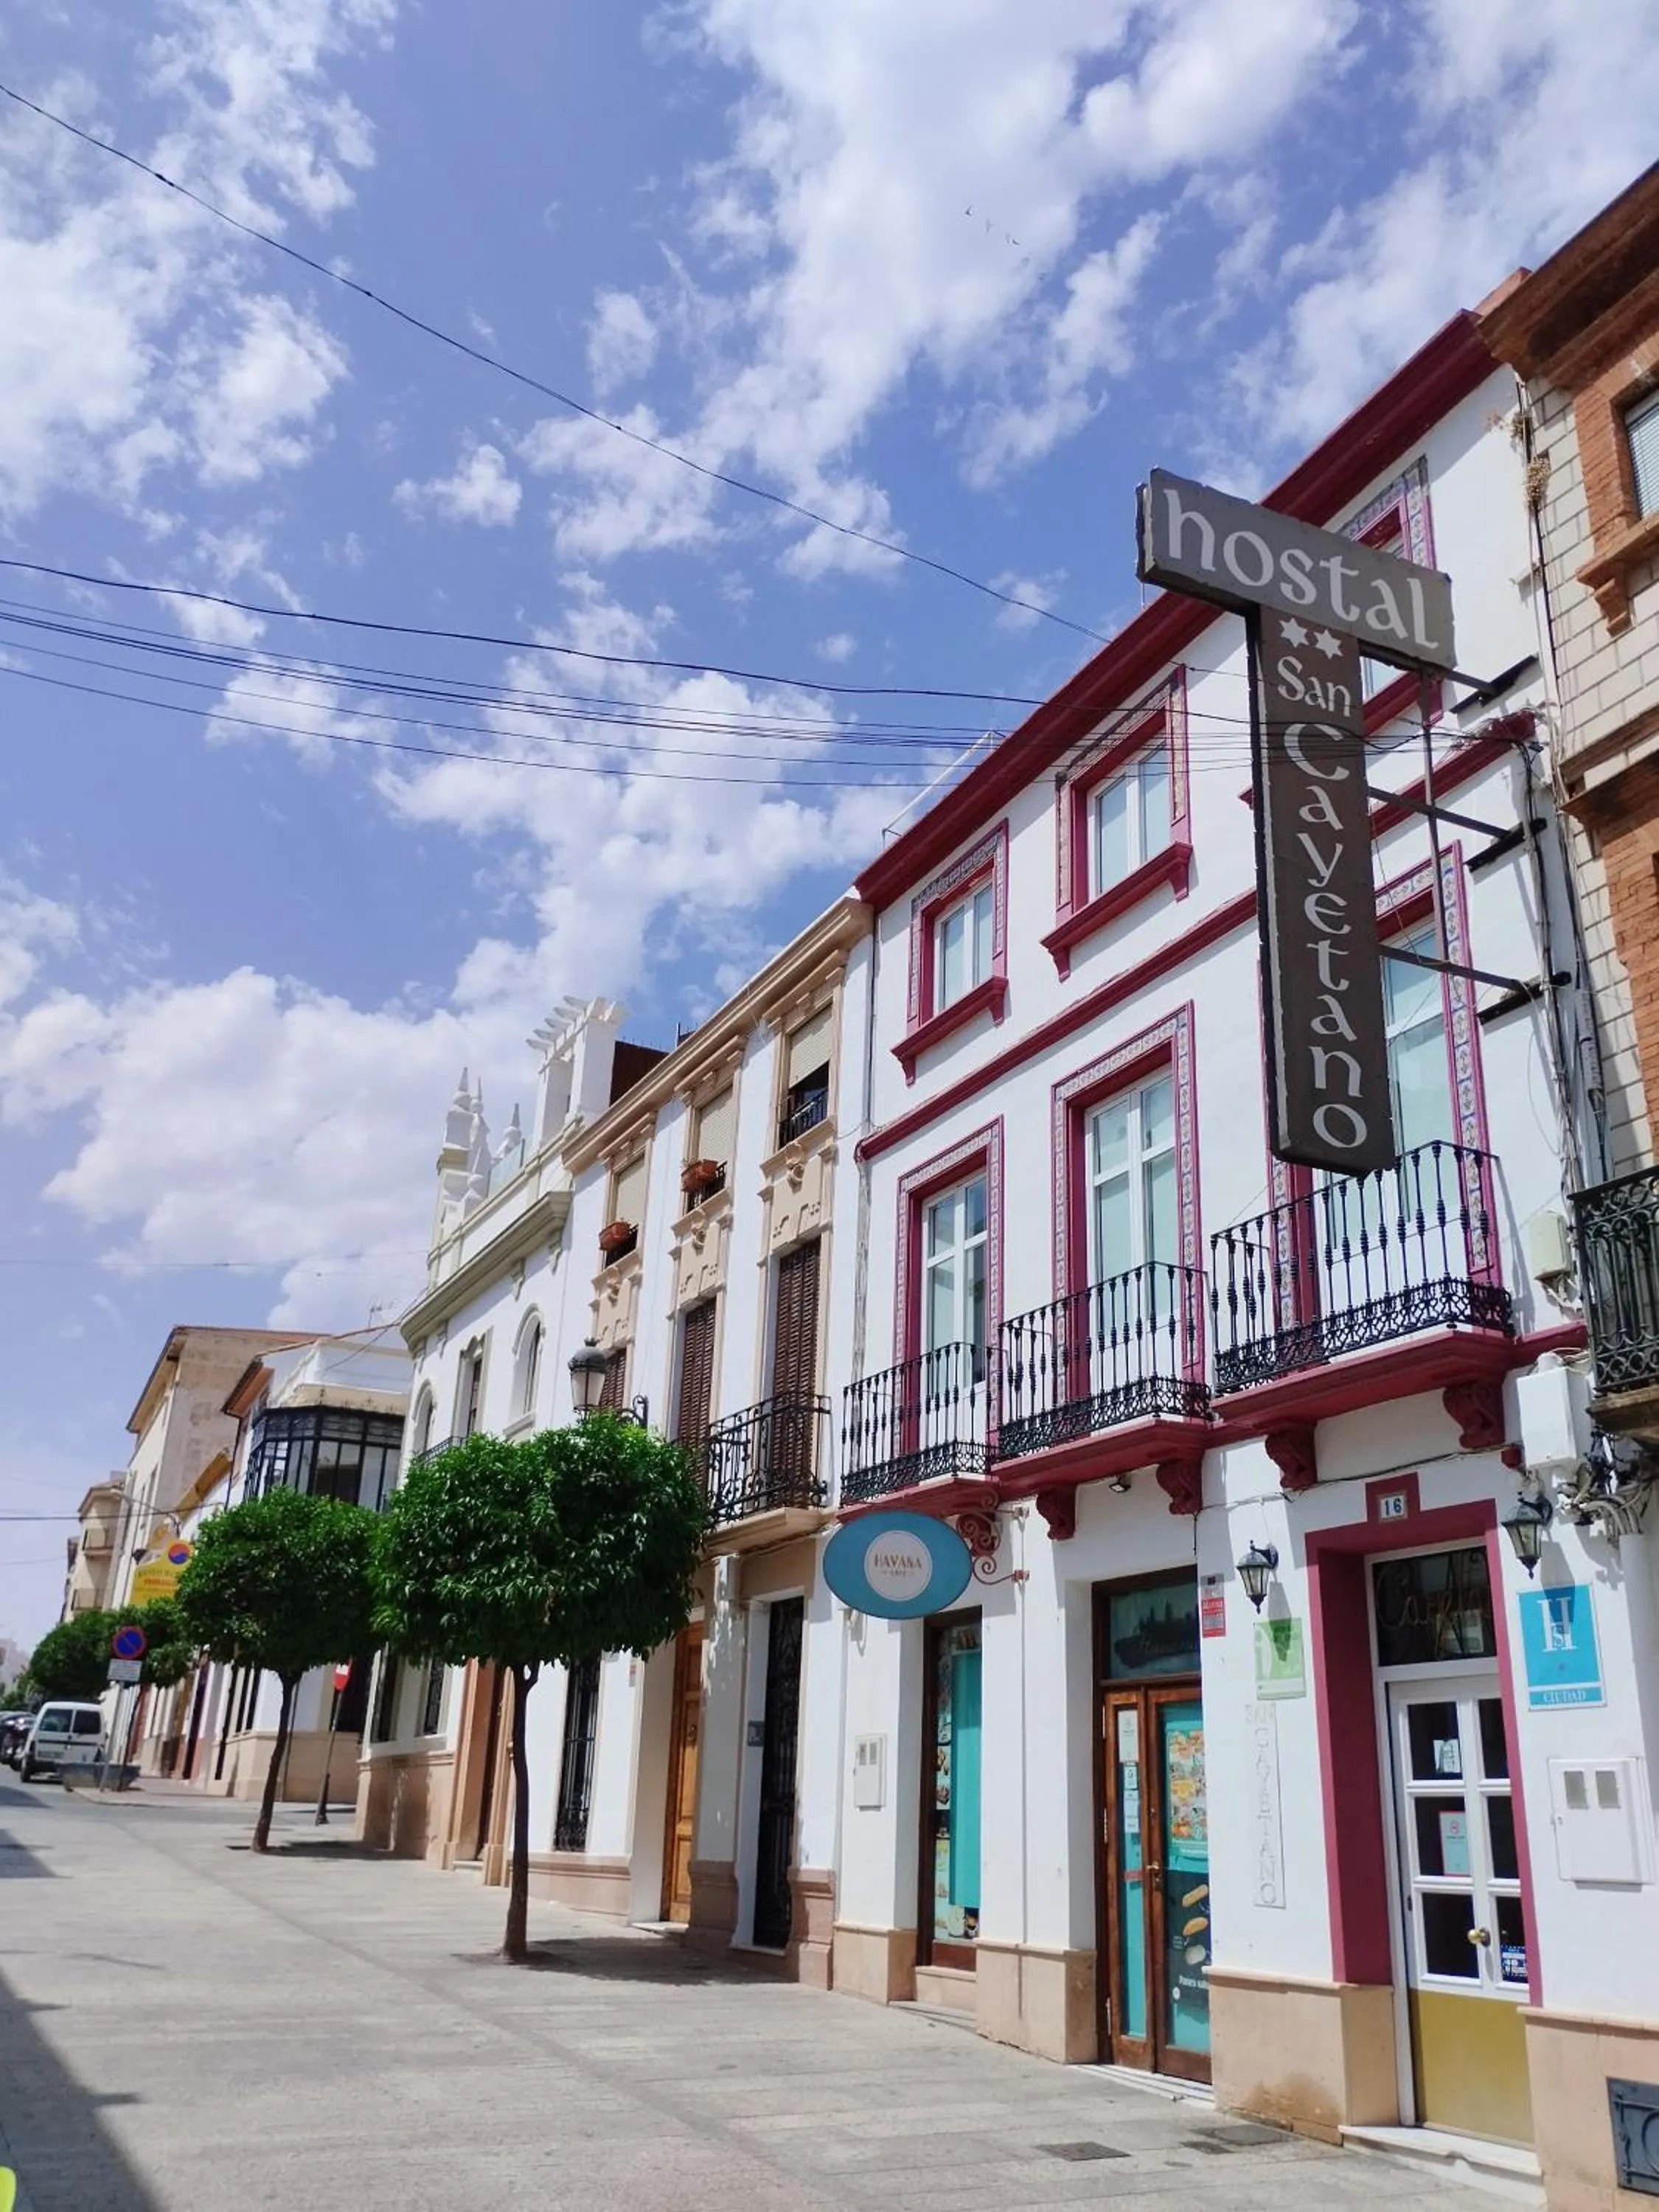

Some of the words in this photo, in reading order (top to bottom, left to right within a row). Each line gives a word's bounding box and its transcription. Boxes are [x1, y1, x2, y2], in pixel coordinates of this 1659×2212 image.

[1164, 488, 1439, 650] hostal
[1276, 655, 1352, 717] San
[1283, 722, 1368, 1149] Cayetano
[1384, 1497, 1402, 1516] 16
[874, 1553, 922, 1570] HAVANA
